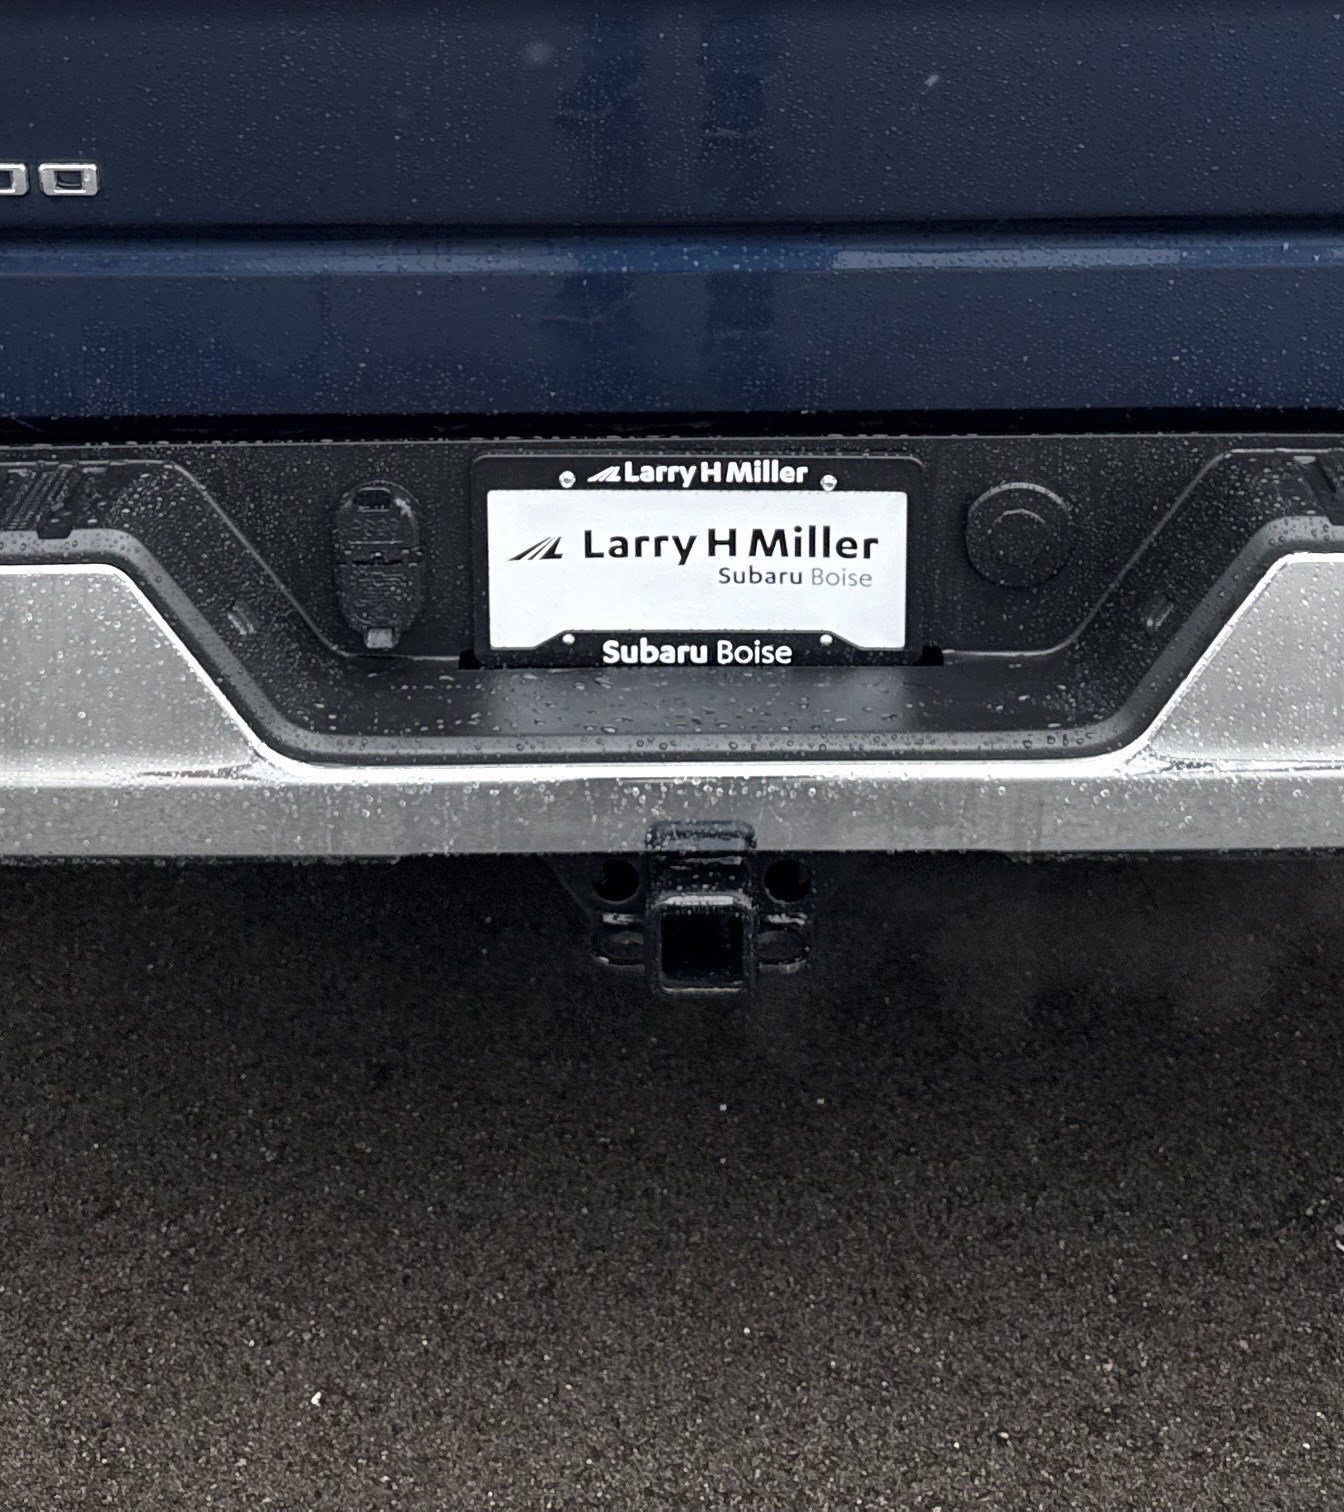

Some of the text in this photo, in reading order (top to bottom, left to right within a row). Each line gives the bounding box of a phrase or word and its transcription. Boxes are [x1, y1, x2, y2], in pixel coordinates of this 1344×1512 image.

[624, 459, 808, 488] Larry H Miller
[583, 525, 879, 566] Larry H Miller
[718, 566, 873, 587] Subaru Boise
[602, 639, 793, 665] Subaru Boise
